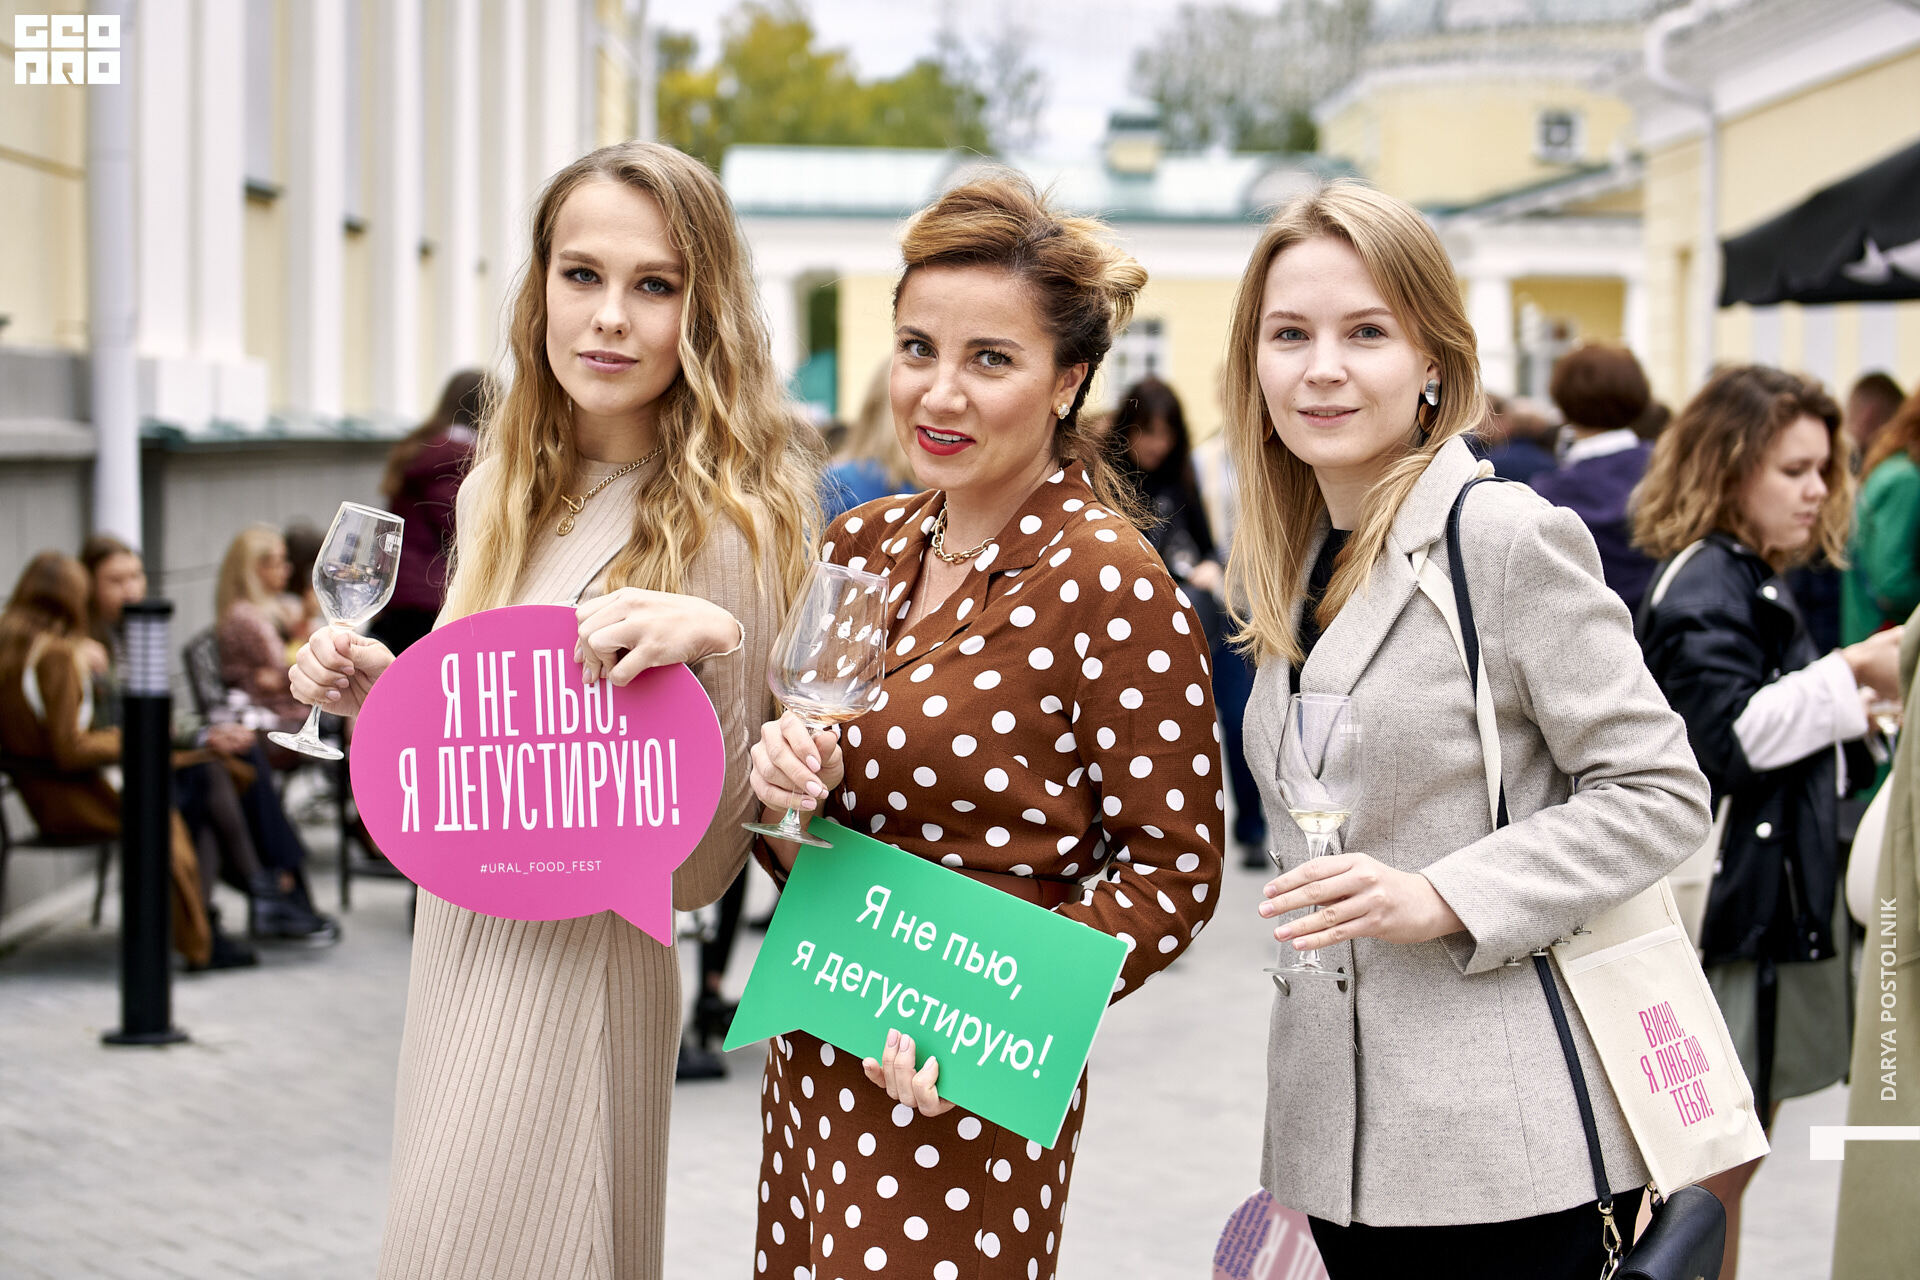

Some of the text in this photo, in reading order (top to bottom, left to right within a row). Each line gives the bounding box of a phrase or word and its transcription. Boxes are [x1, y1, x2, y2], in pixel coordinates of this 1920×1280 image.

[441, 648, 628, 739] Я НЕ ПЬЮ,
[398, 738, 680, 833] Я ДЕГУСТИРУЮ!
[480, 859, 602, 876] #URAL_FOOD_FEST
[856, 884, 1023, 1001] Я не пью,
[791, 940, 1054, 1079] я дегустирую!
[1638, 1000, 1686, 1049] ВИНО,
[1639, 1035, 1710, 1094] Я ЛЮБЛЮ
[1669, 1079, 1715, 1127] ТЕБЯ!
